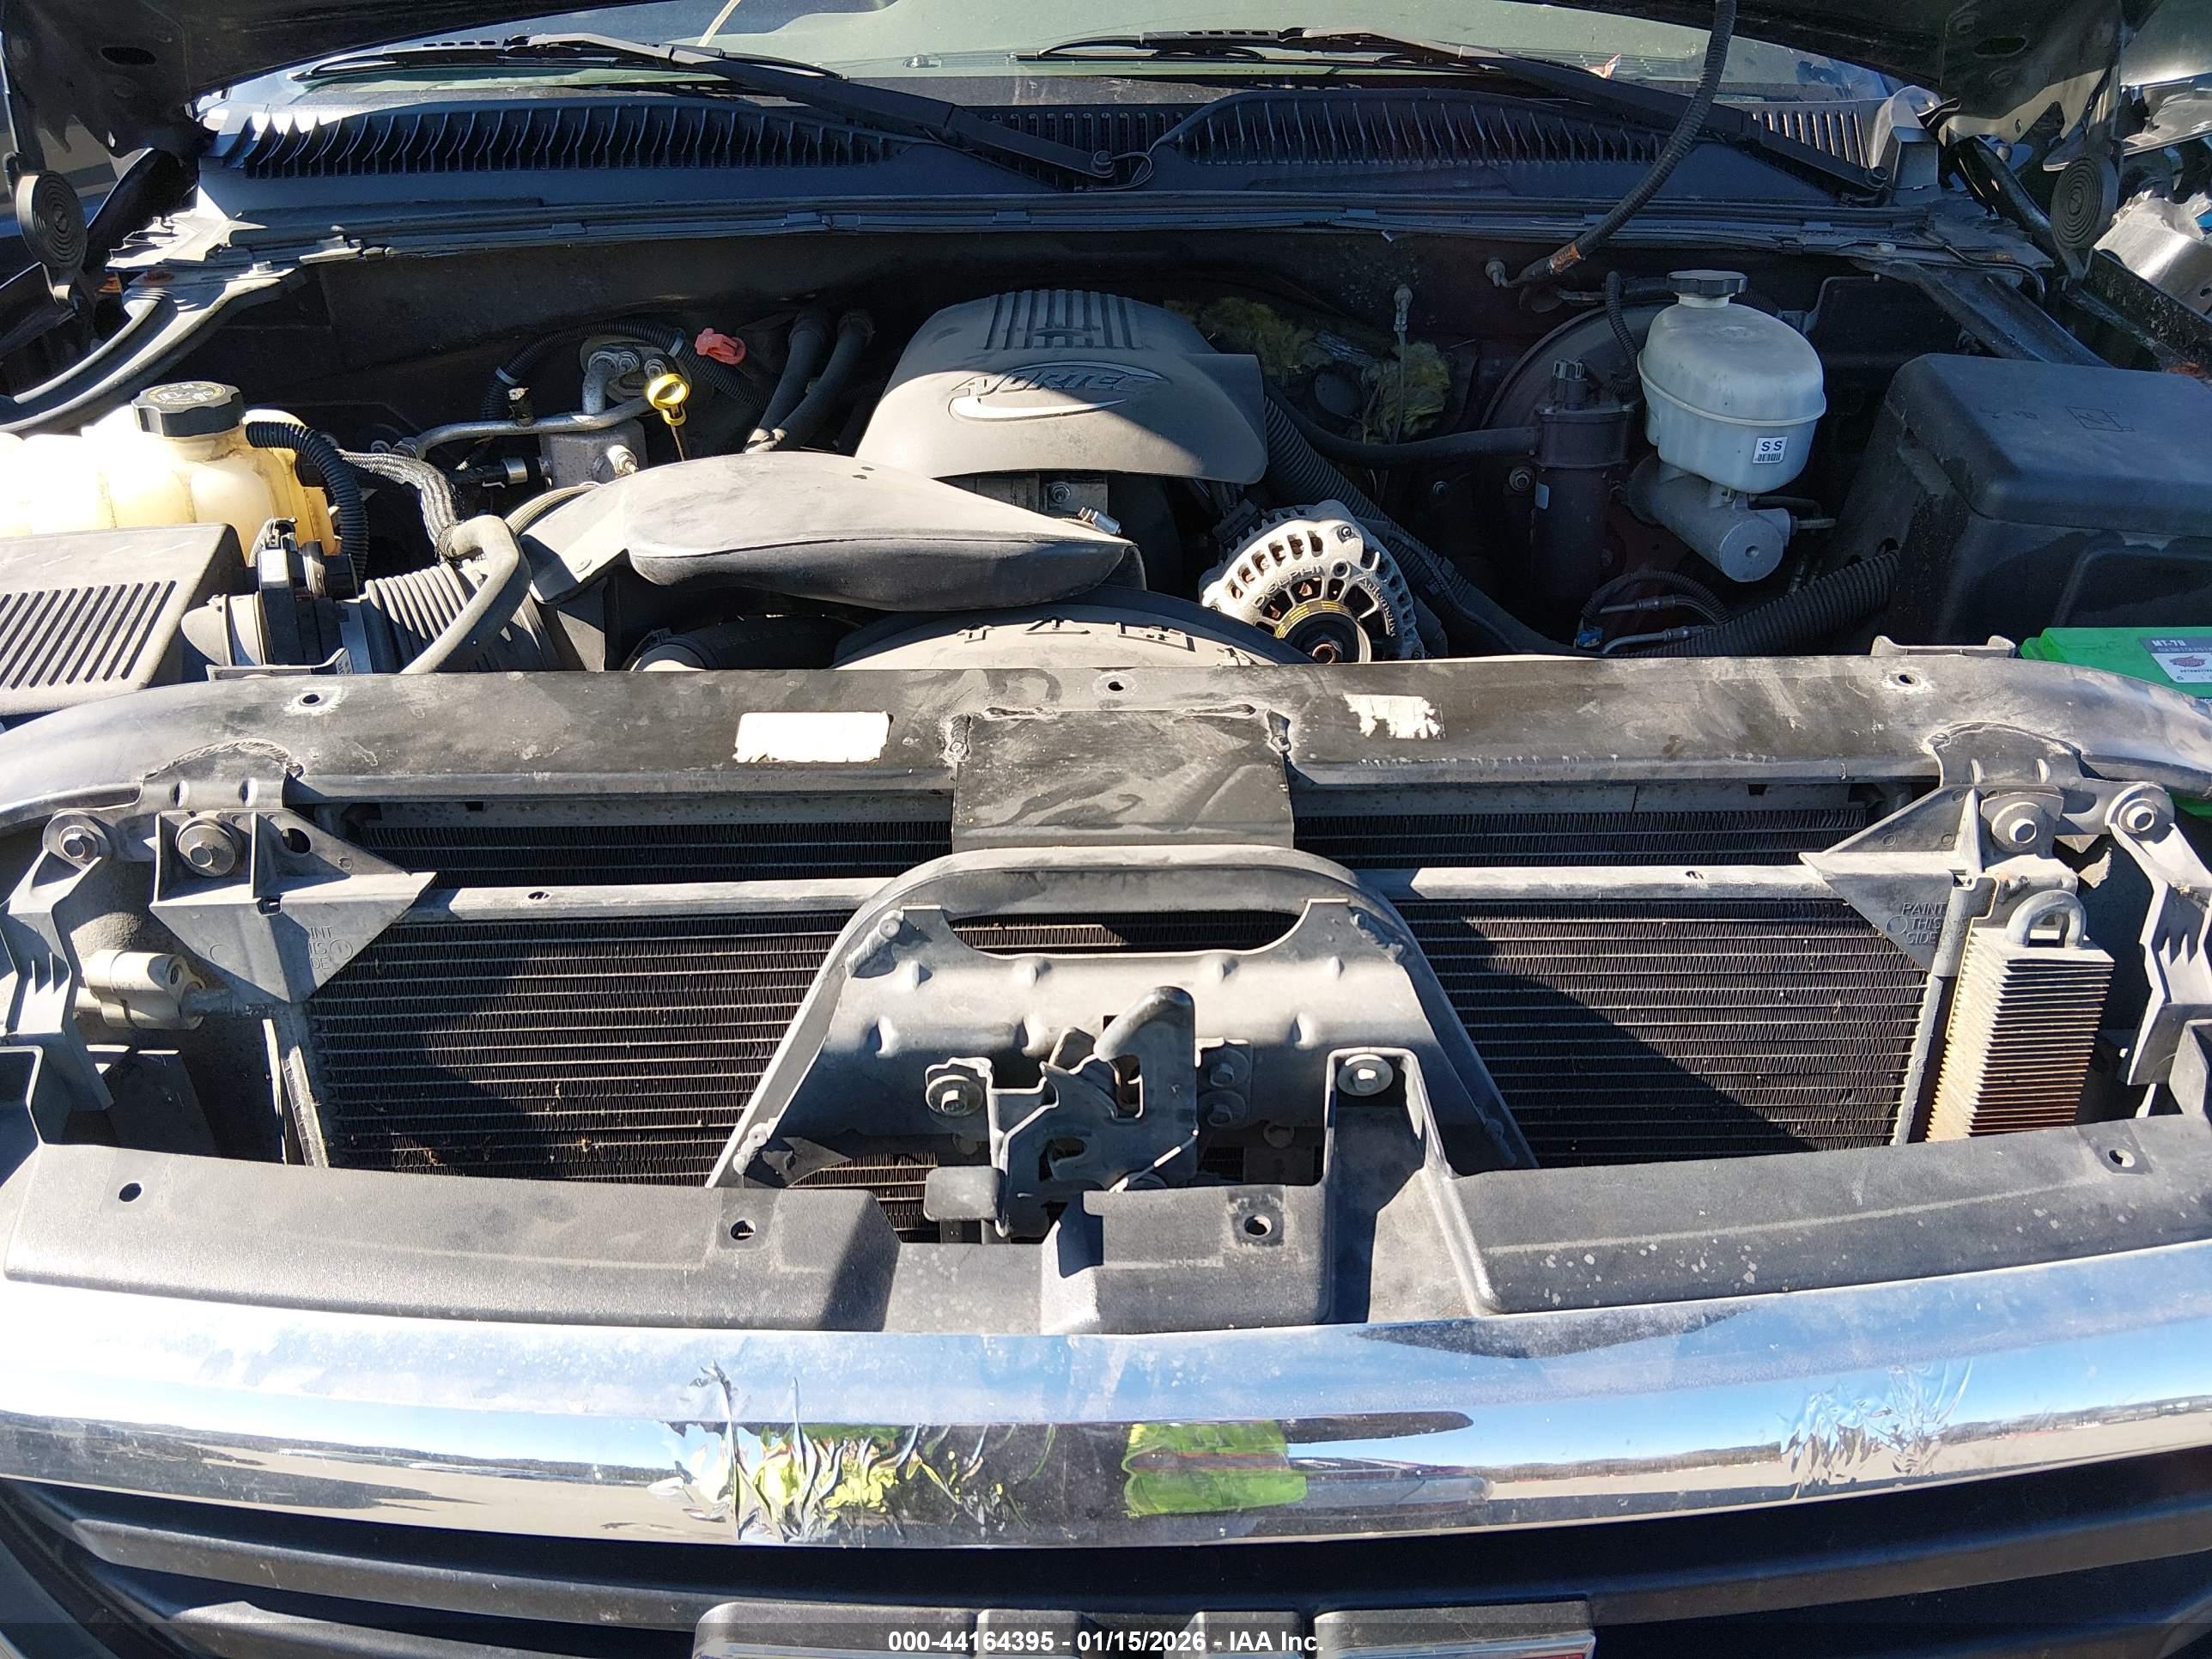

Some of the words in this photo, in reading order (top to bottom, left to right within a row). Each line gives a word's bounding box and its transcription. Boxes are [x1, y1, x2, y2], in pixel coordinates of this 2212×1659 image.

[951, 370, 1159, 397] VORTEC
[1901, 902, 1947, 915] PAINT
[1910, 916, 1942, 930] THIS
[1906, 931, 1938, 945] SIDE
